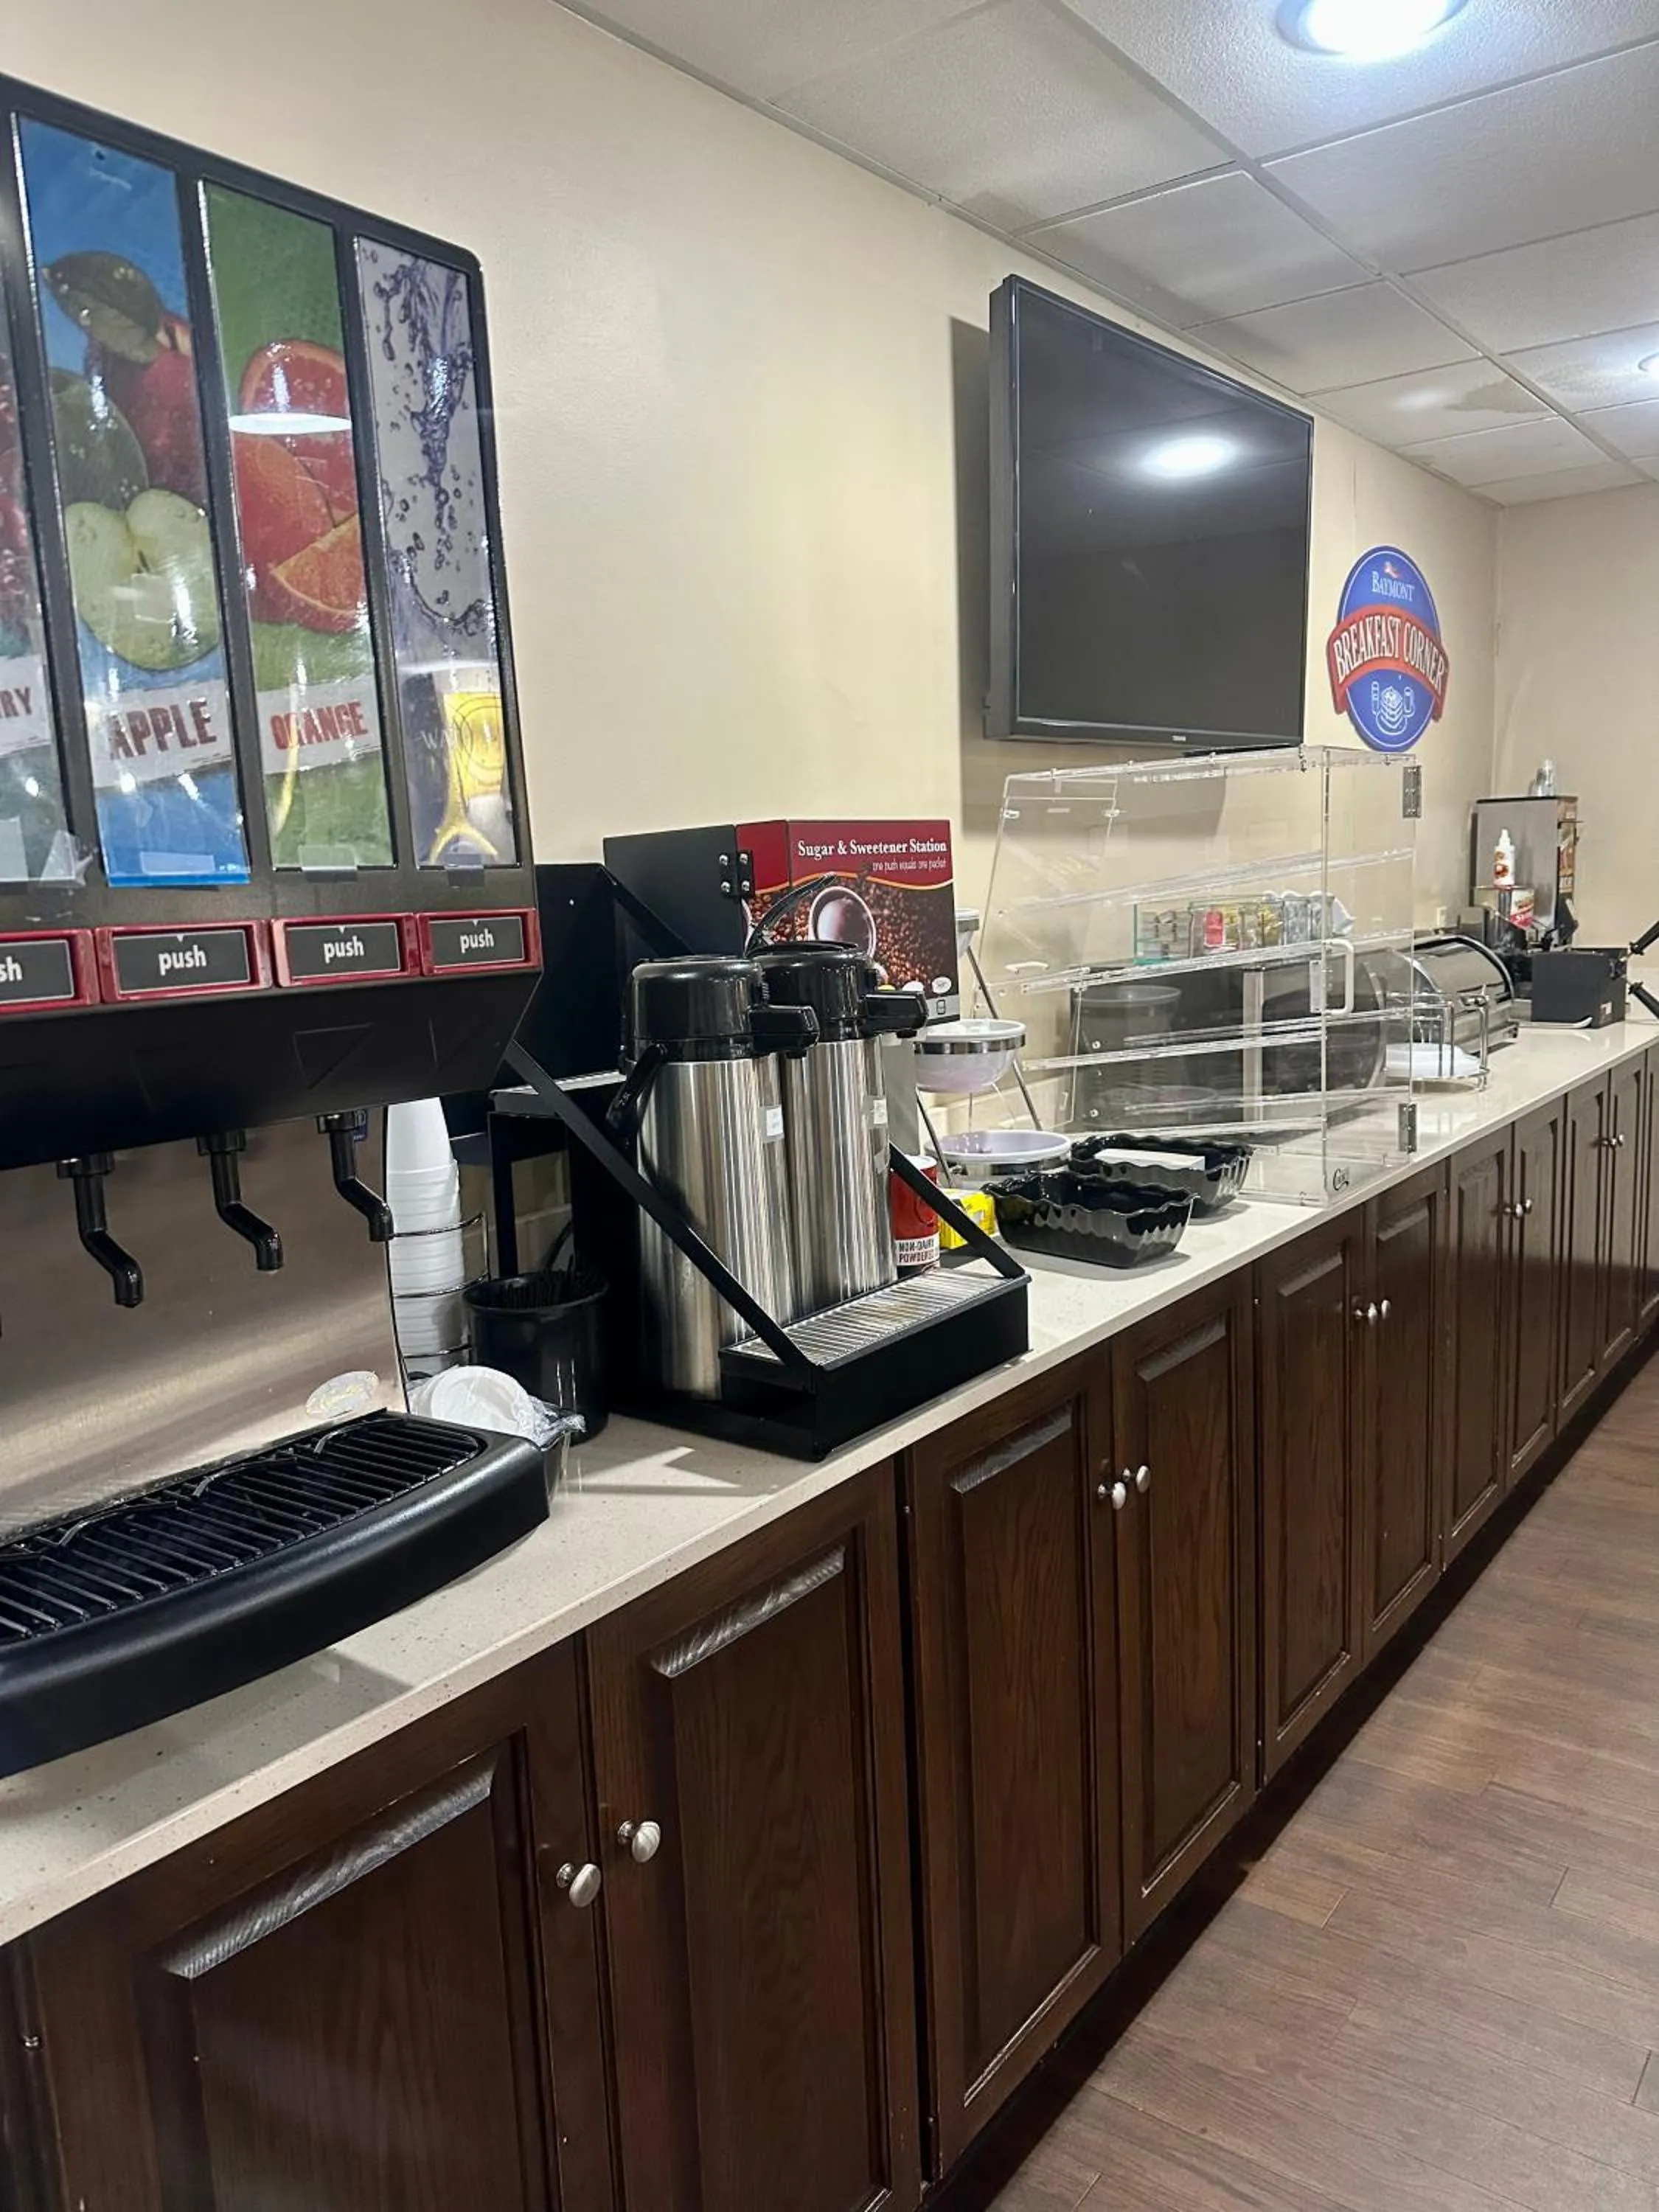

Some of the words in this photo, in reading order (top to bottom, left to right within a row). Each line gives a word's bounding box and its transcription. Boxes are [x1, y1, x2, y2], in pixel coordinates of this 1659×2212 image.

[1371, 571, 1414, 602] BAYMONT
[1333, 615, 1402, 684] BREAKFAST
[1403, 623, 1445, 696] CORNER
[0, 686, 32, 718] RY
[108, 698, 218, 760] APPLE
[797, 840, 835, 860] Sugar
[837, 840, 847, 855] &
[850, 838, 908, 855] Sweetener
[909, 837, 947, 853] Station
[324, 935, 365, 964] push
[459, 928, 495, 953] push
[159, 945, 207, 976] push
